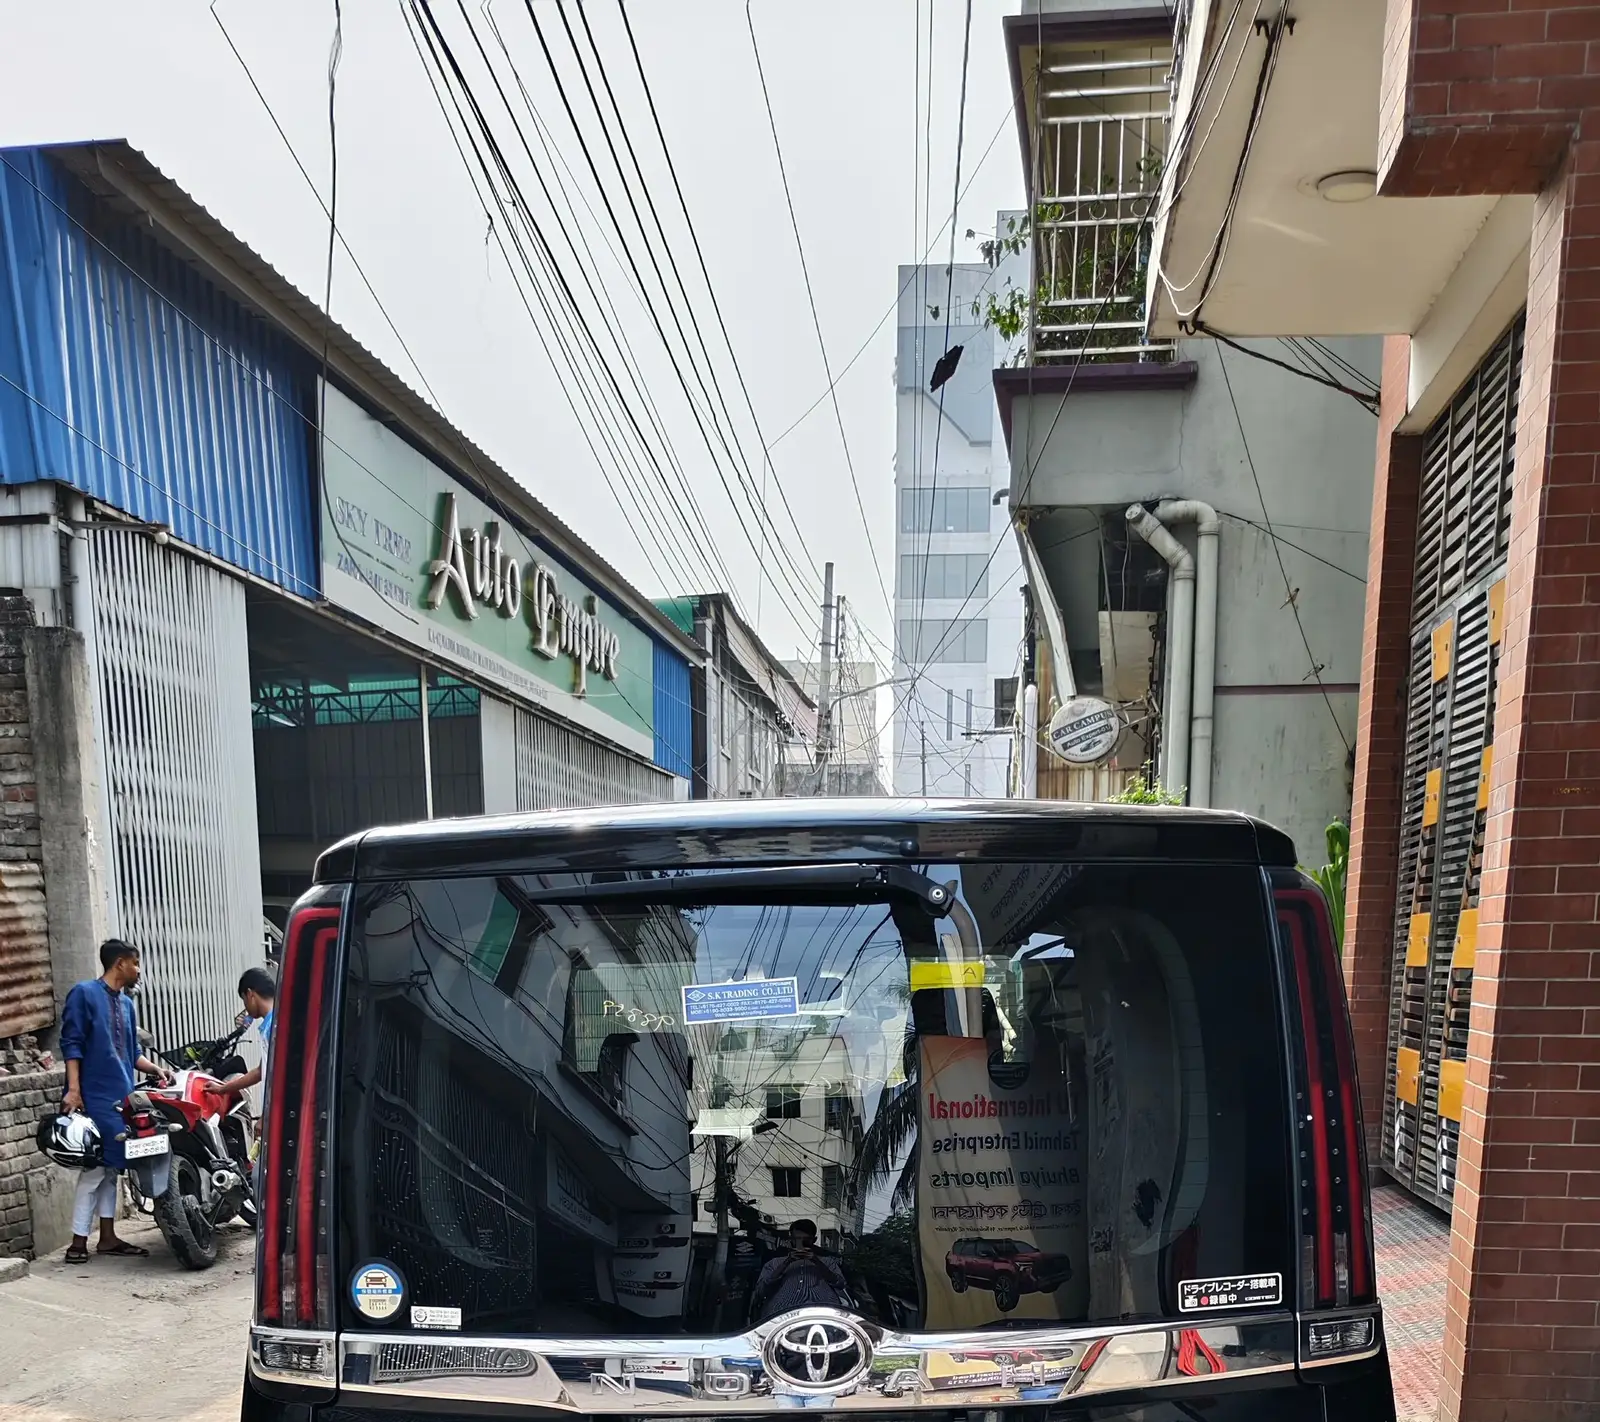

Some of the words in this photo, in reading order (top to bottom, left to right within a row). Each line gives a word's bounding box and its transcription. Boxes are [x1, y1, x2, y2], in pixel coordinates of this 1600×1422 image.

[428, 492, 522, 620] Auto
[533, 563, 620, 699] Empire
[1053, 726, 1073, 739] CAR
[1073, 710, 1113, 730] CAMPUS
[963, 966, 976, 978] A
[722, 989, 758, 998] TRADING
